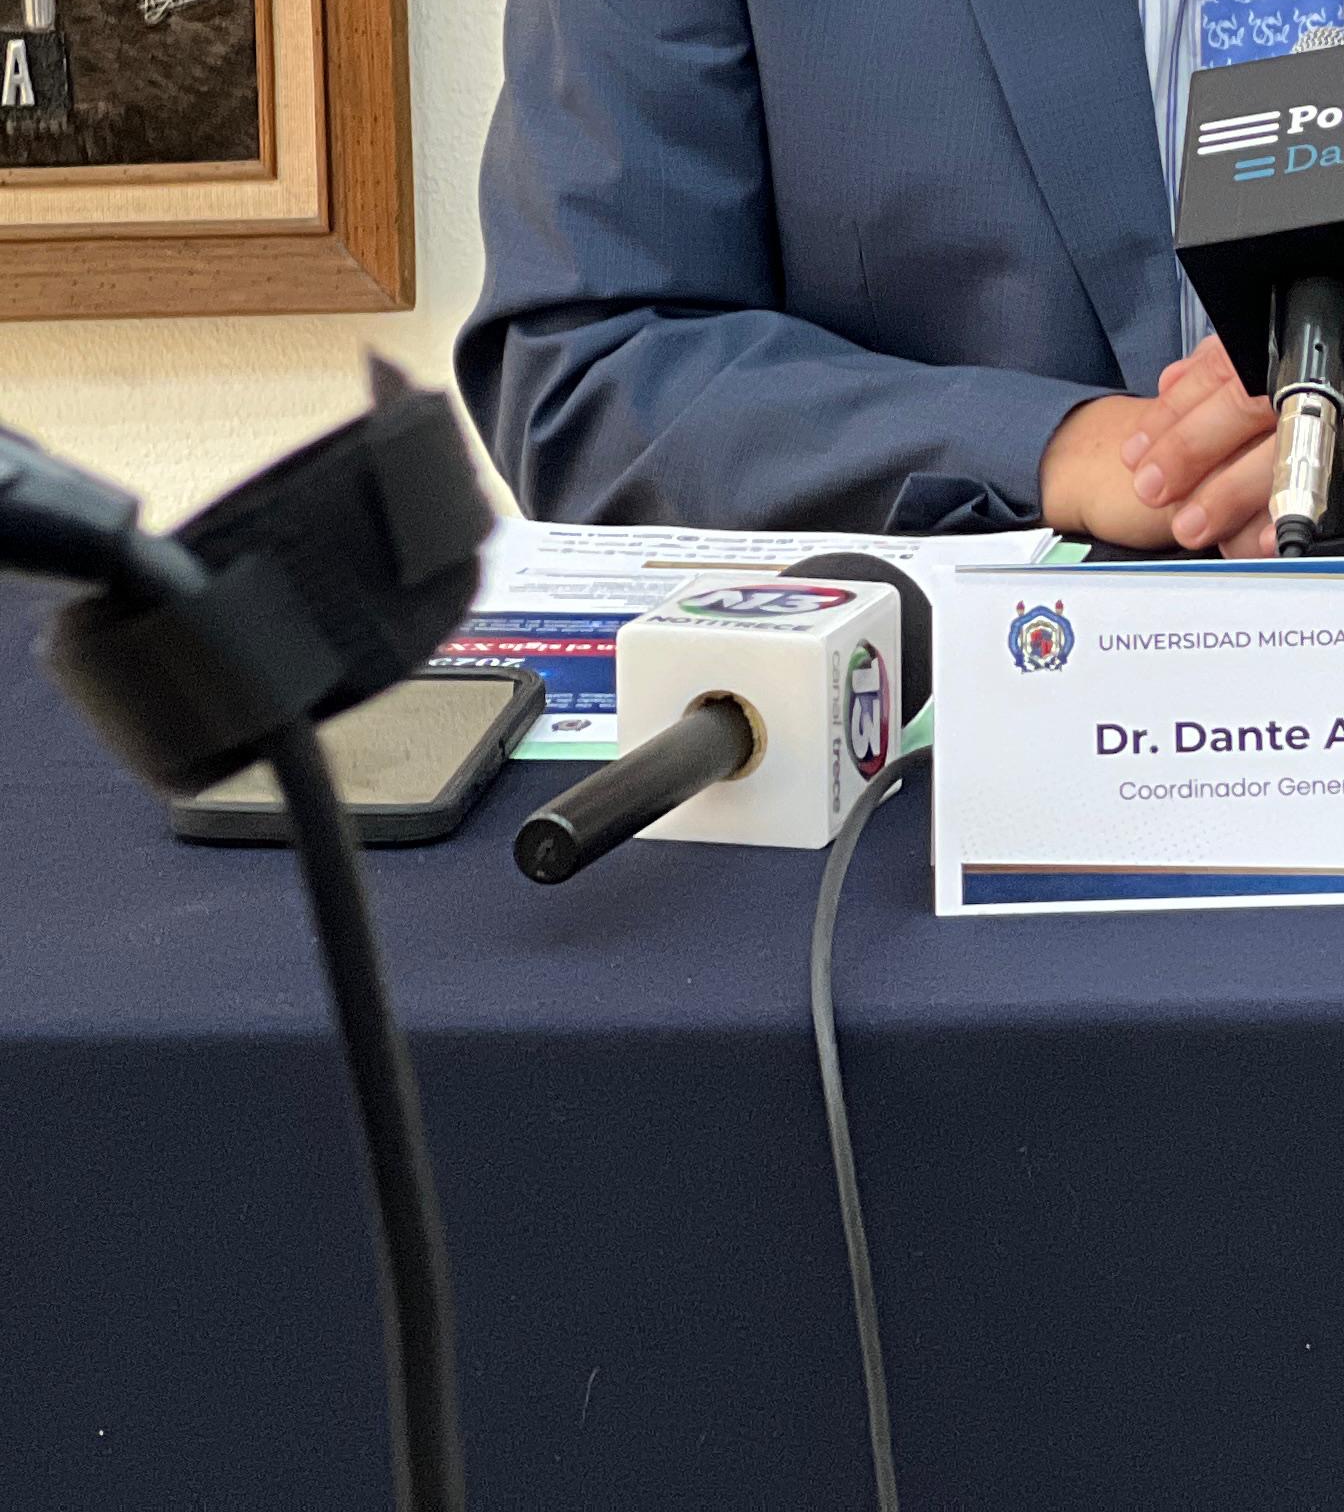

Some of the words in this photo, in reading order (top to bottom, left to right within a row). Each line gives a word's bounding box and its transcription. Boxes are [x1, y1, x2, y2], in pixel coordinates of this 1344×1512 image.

[647, 615, 814, 632] NOTITRECE
[1099, 632, 1251, 650] UNIVERSIDAD
[1097, 723, 1158, 755] Dr.
[1175, 721, 1309, 752] Dante
[832, 739, 842, 814] trece
[1119, 778, 1270, 800] Coordinador
